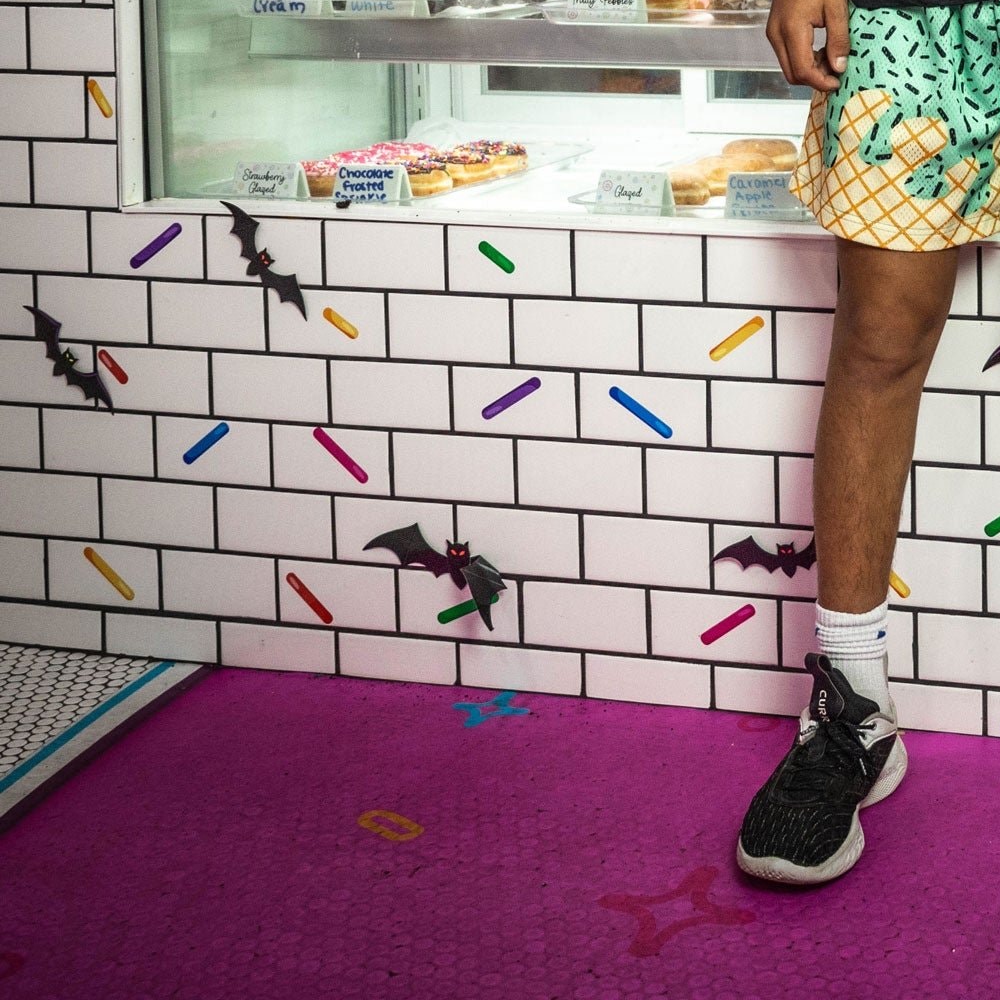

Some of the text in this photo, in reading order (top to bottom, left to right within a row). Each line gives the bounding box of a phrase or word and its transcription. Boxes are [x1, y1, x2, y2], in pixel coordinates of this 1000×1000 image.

[242, 169, 285, 185] Strawberry
[339, 166, 394, 180] Chocolate
[248, 183, 276, 194] Glazed
[730, 176, 787, 189] Caramel
[614, 185, 642, 200] Glazed
[735, 191, 772, 203] Apple
